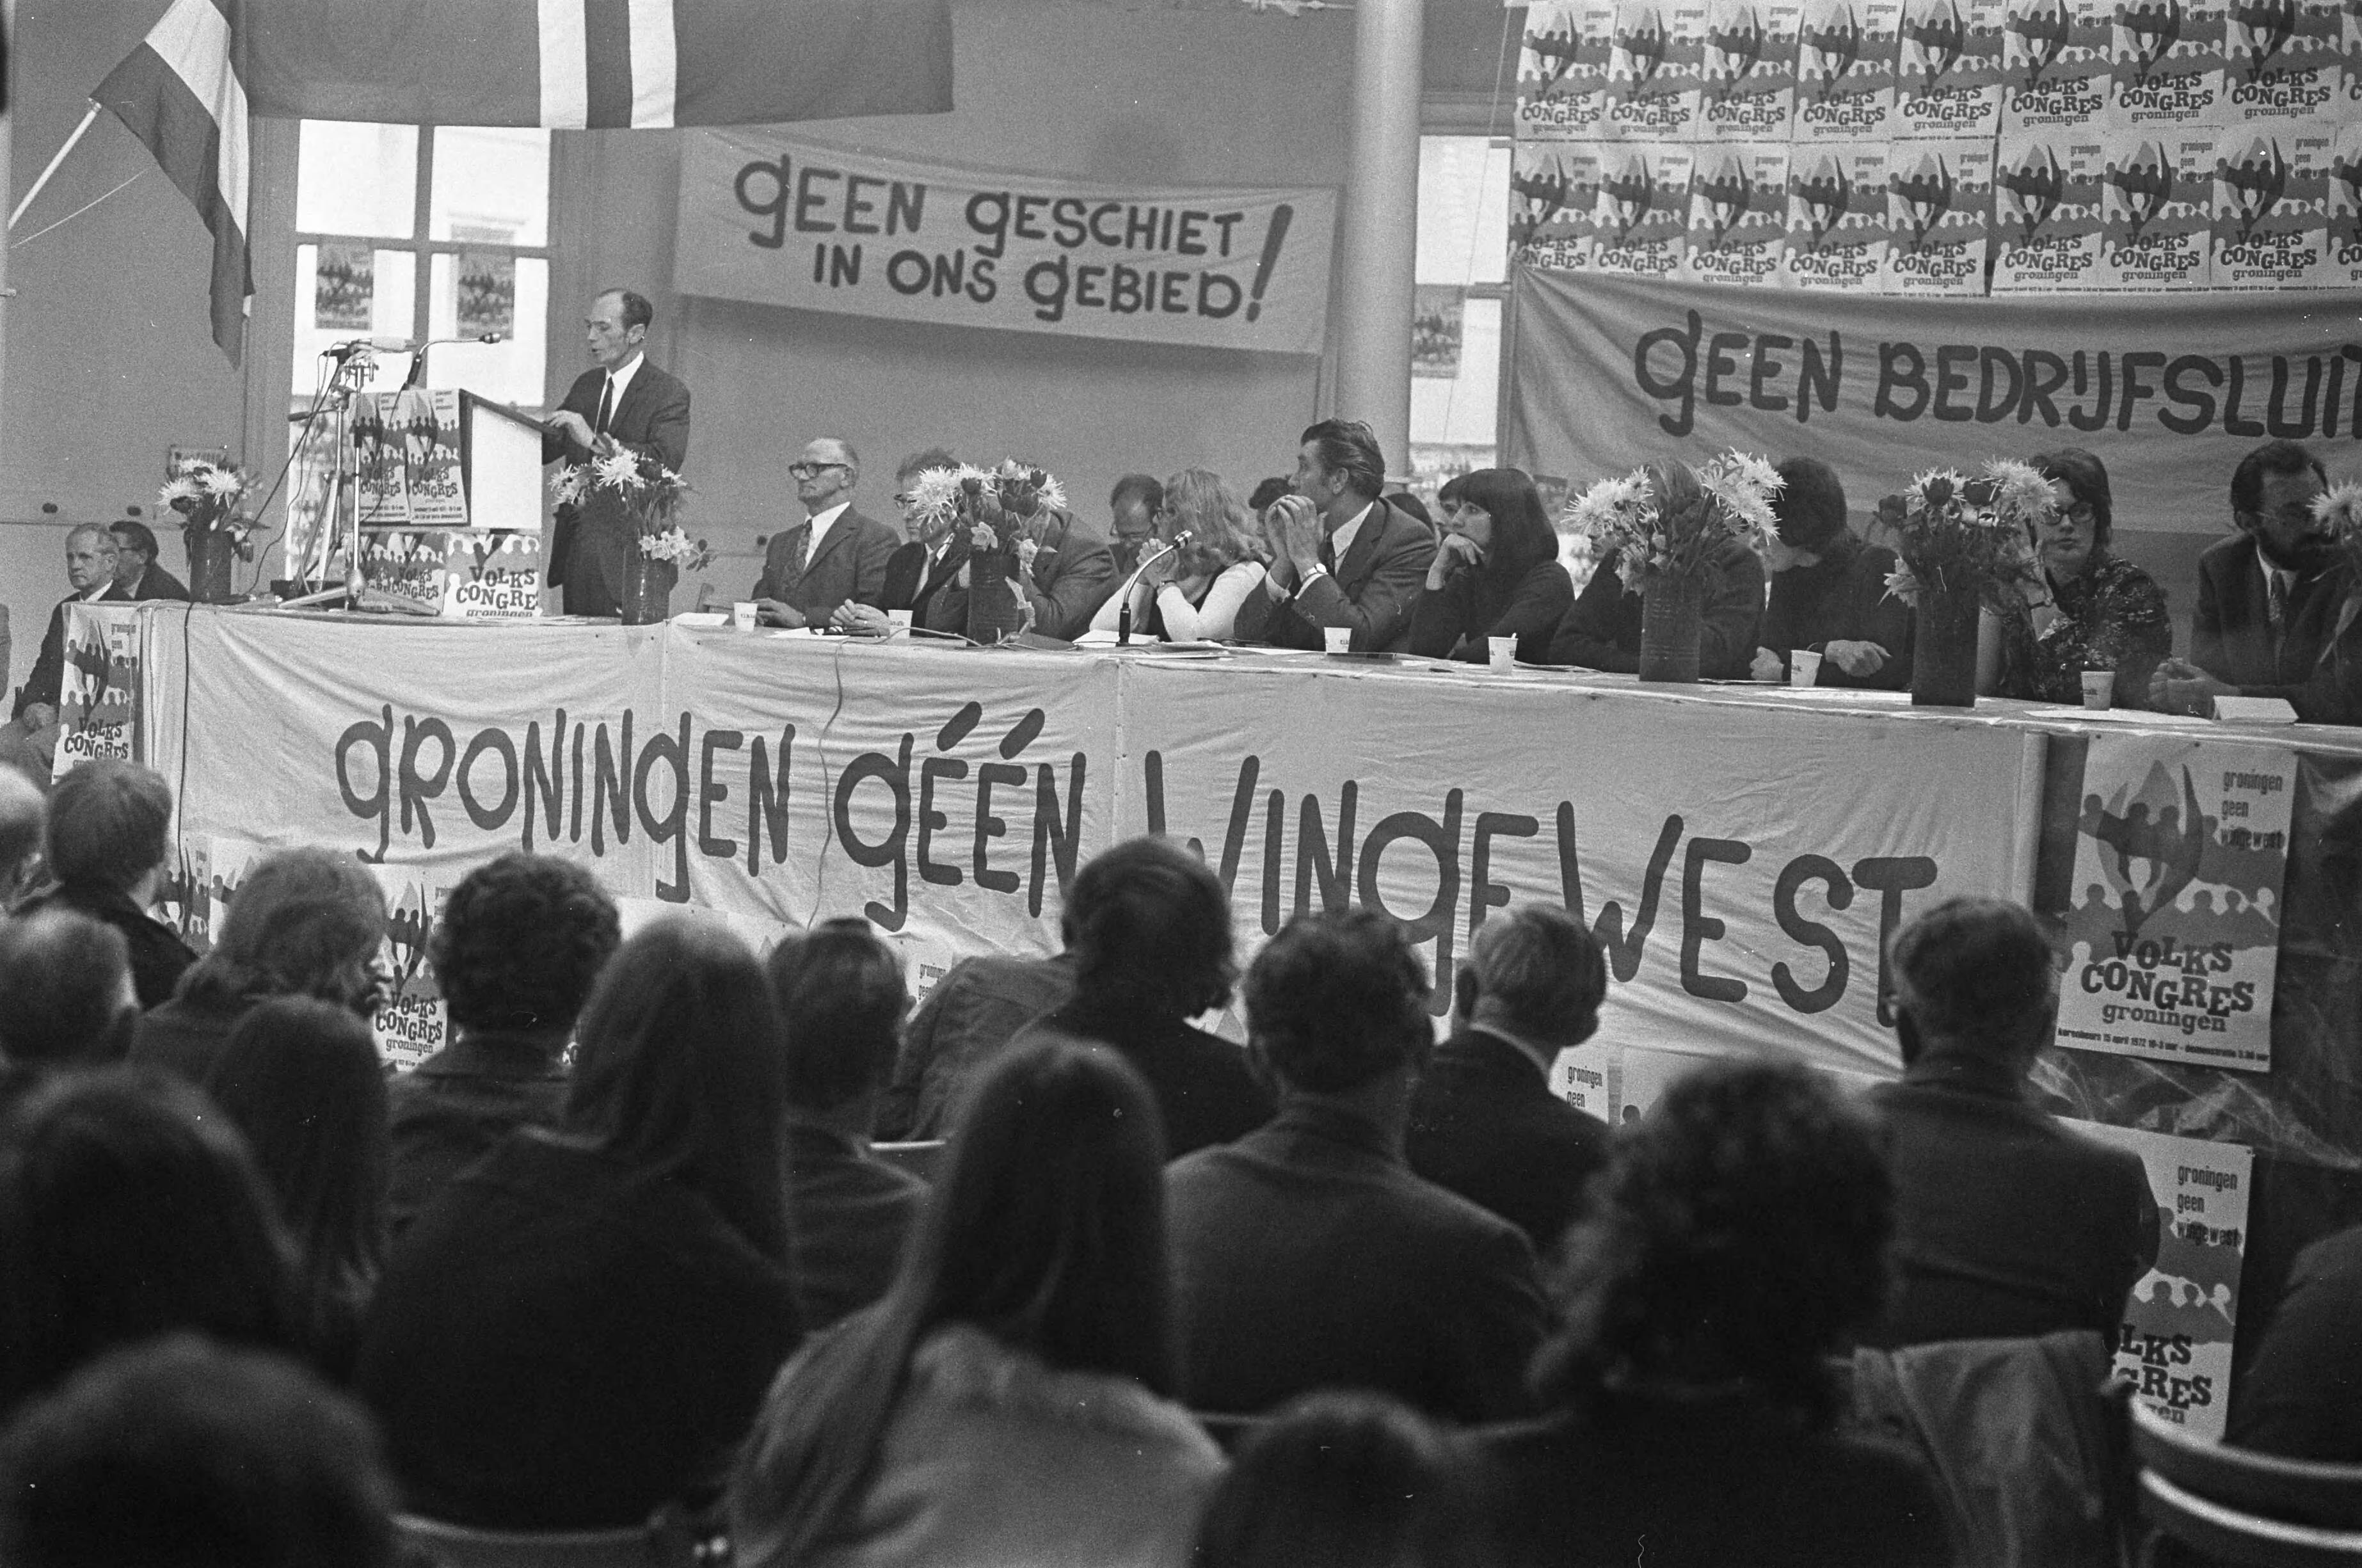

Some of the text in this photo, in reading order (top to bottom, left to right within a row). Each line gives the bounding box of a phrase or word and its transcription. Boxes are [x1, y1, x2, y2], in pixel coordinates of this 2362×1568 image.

[2025, 76, 2089, 96] VOLKS
[2134, 71, 2202, 91] VOLKS
[2247, 67, 2318, 88] VOLKS
[1920, 84, 1983, 102] VOLKS
[2119, 89, 2214, 111] CONGRES
[2231, 85, 2331, 108] CONGRES
[1522, 105, 1600, 124] CONGRES
[1707, 105, 1785, 124] CONGRES
[1903, 100, 1993, 121] CONGRES
[2011, 94, 2103, 115] CONGRES
[2245, 106, 2315, 120] groningen
[1611, 105, 1689, 125] CONGRES
[1803, 105, 1886, 125] CONGRES
[2023, 115, 2089, 127] groningen
[2131, 109, 2199, 123] groningen
[1914, 120, 1976, 131] groningen
[1910, 240, 1966, 258] VOLKS
[2021, 234, 2082, 253] VOLKS
[2126, 232, 2189, 252] VOLKS
[2236, 229, 2304, 250] VOLKS
[1807, 241, 1867, 259] VOLKS
[2221, 248, 2317, 270] CONGRES
[1599, 252, 1677, 271] CONGRES
[1693, 254, 1776, 275] CONGRES
[1790, 256, 1877, 277] CONGRES
[1894, 257, 1977, 277] CONGRES
[2004, 250, 2093, 271] CONGRES
[2112, 250, 2200, 271] CONGRES
[814, 243, 861, 287] IN
[886, 249, 996, 303] ONS
[1703, 275, 1763, 285] groningen
[1800, 276, 1862, 287] groningen
[1904, 276, 1963, 288] groningen
[2014, 271, 2078, 282] groningen
[2121, 271, 2187, 282] groningen
[2233, 269, 2302, 281] groningen
[412, 482, 458, 497] CONGRES
[468, 566, 535, 589] VOLKS
[392, 580, 439, 600] CONGRES
[456, 584, 538, 610] CONGRE
[79, 717, 123, 740] VOLKS
[2223, 768, 2283, 795] groningen
[2221, 799, 2249, 819] geen
[2112, 931, 2233, 977] VOLKS
[2081, 961, 2255, 1018] CONGRES
[390, 992, 436, 1019] VOLKS
[375, 1011, 442, 1044] CONGRES
[2102, 1002, 2227, 1036] groningen
[386, 1037, 433, 1057] groningen
[1568, 1066, 1602, 1089] groningen
[2178, 1165, 2237, 1192] groningen
[2177, 1192, 2205, 1214] geen
[2177, 1219, 2242, 1248] wingewest
[2120, 1324, 2192, 1367] LKS
